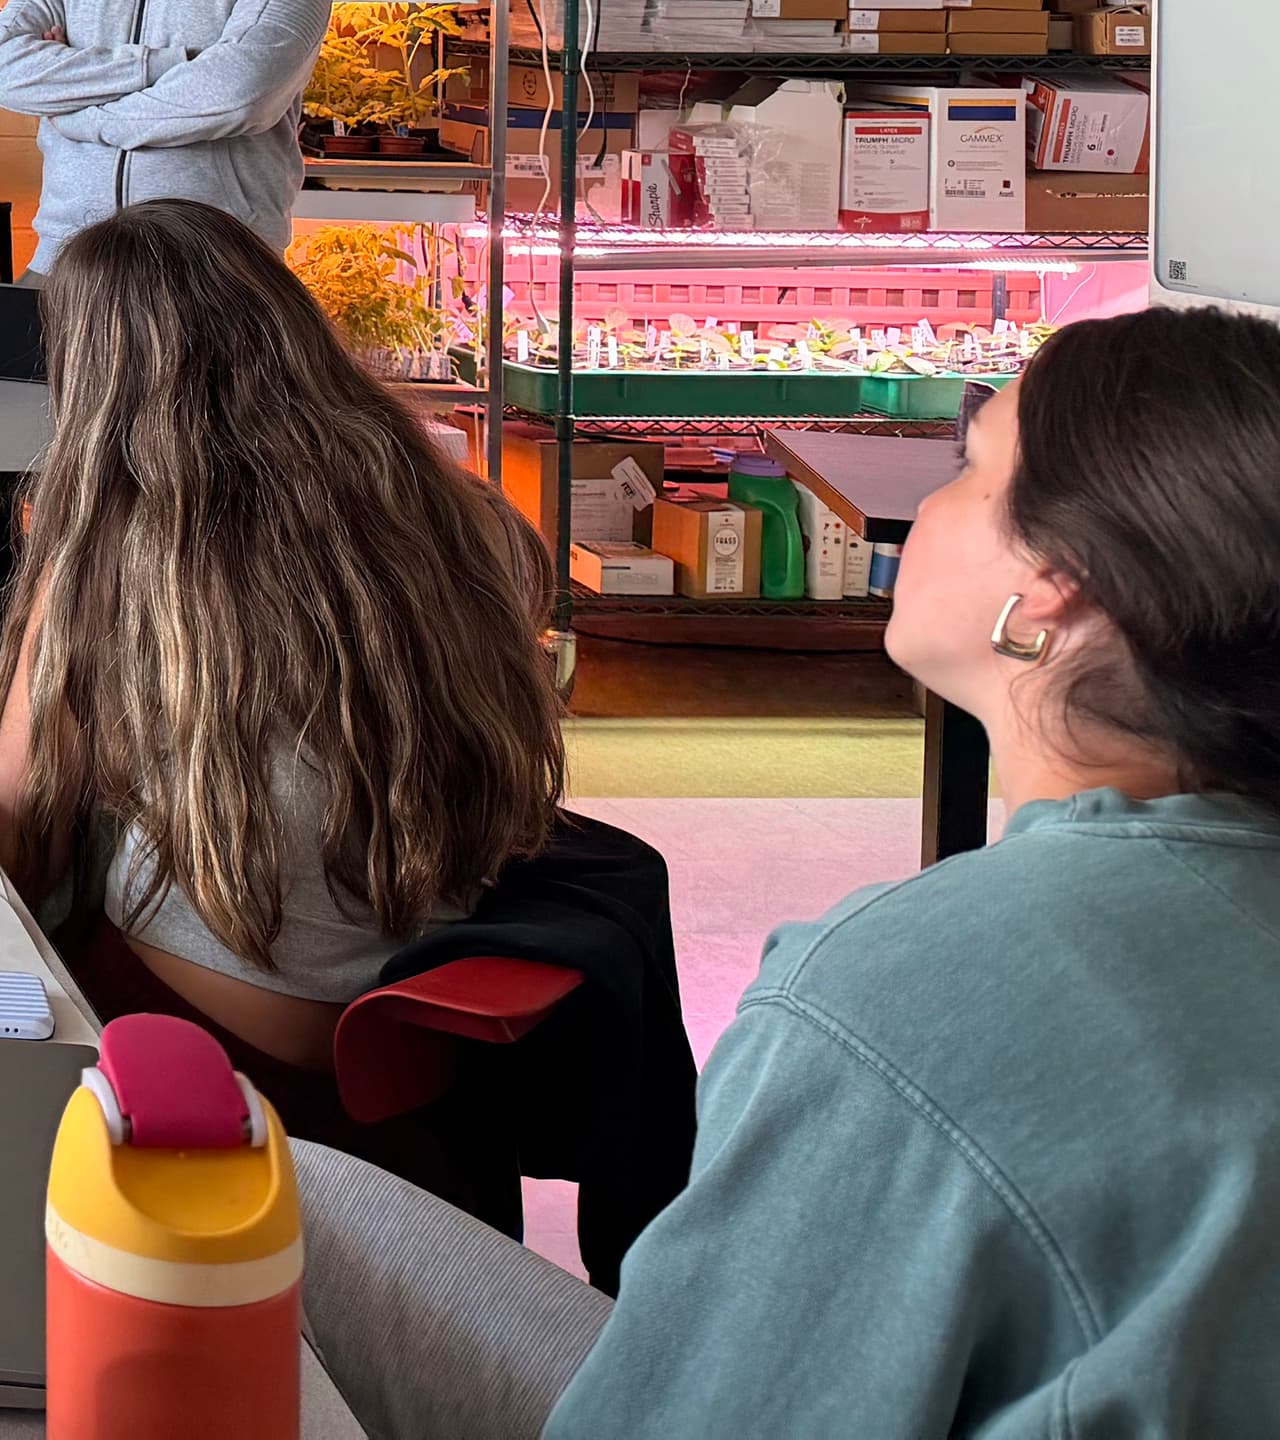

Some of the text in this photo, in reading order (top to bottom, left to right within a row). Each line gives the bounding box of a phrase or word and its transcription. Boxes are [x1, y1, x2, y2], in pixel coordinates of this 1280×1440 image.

[960, 134, 1003, 143] GAMMEX
[648, 183, 663, 228] Sharpie
[715, 537, 737, 545] FRASS
